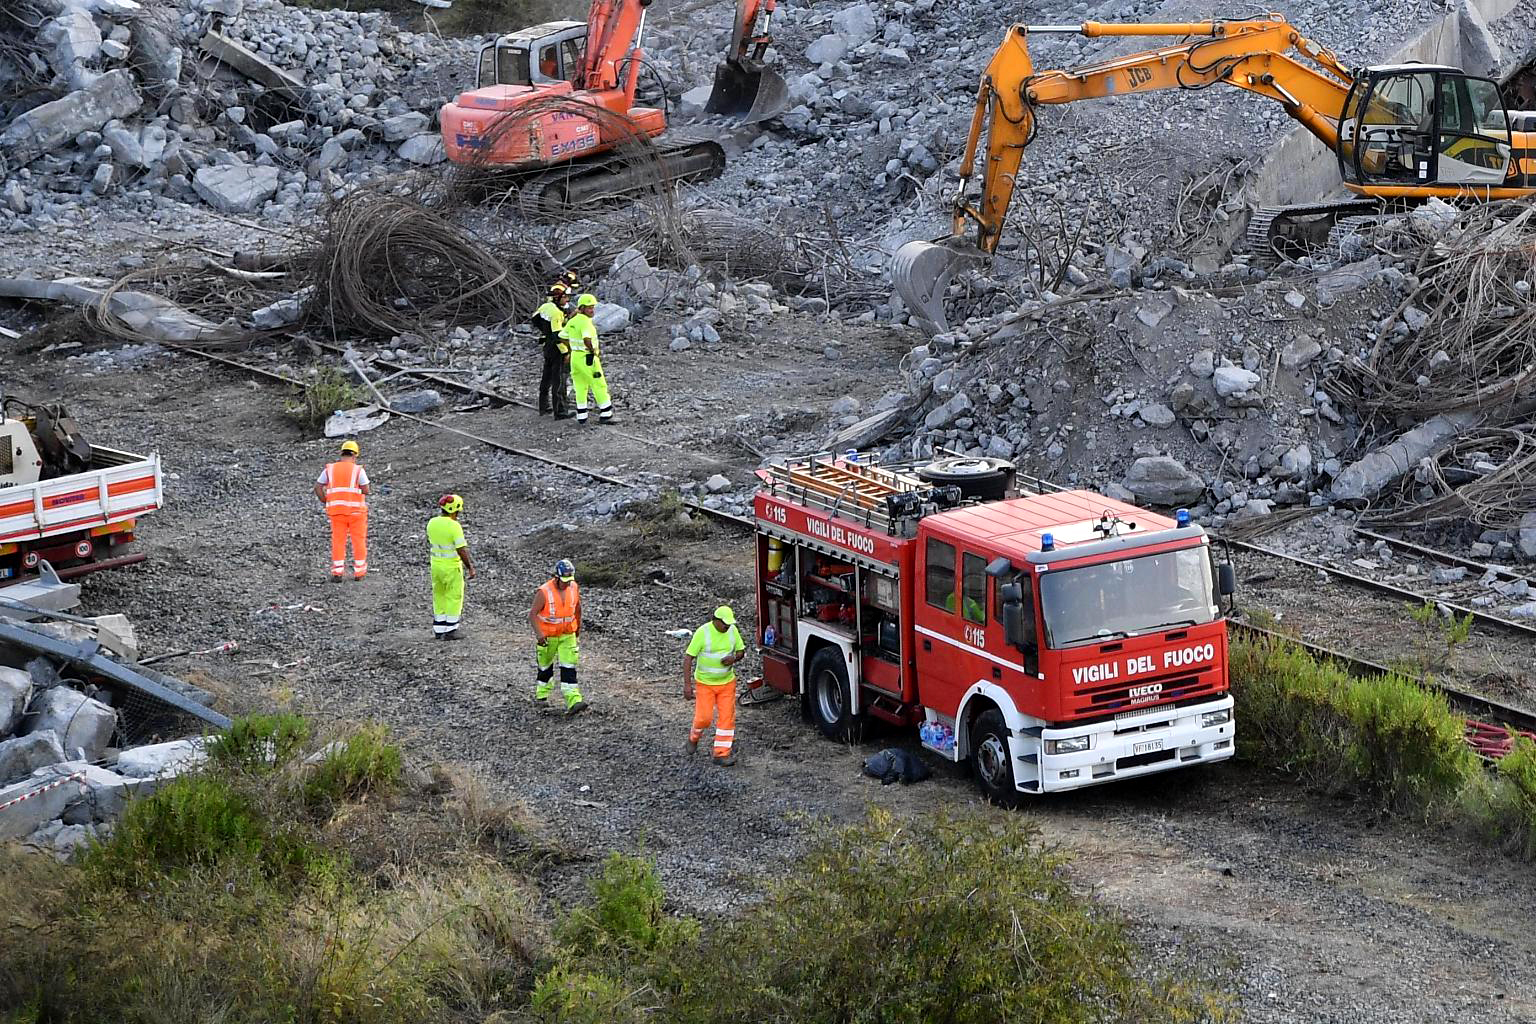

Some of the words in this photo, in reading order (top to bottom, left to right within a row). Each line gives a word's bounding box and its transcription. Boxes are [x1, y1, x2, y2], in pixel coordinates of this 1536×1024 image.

[1127, 67, 1152, 88] JCB
[552, 134, 595, 156] EX135
[773, 505, 787, 524] 115
[806, 517, 830, 538] VIGILI
[831, 525, 846, 544] DEL
[847, 531, 874, 554] FUOCO
[79, 544, 90, 553] 100
[972, 627, 985, 648] 115
[1072, 661, 1118, 685] VIGILI
[1127, 656, 1156, 675] DEL
[1164, 644, 1214, 668] FUOCO
[1129, 683, 1163, 698] IVECO
[1131, 695, 1160, 705] MAGIRUS
